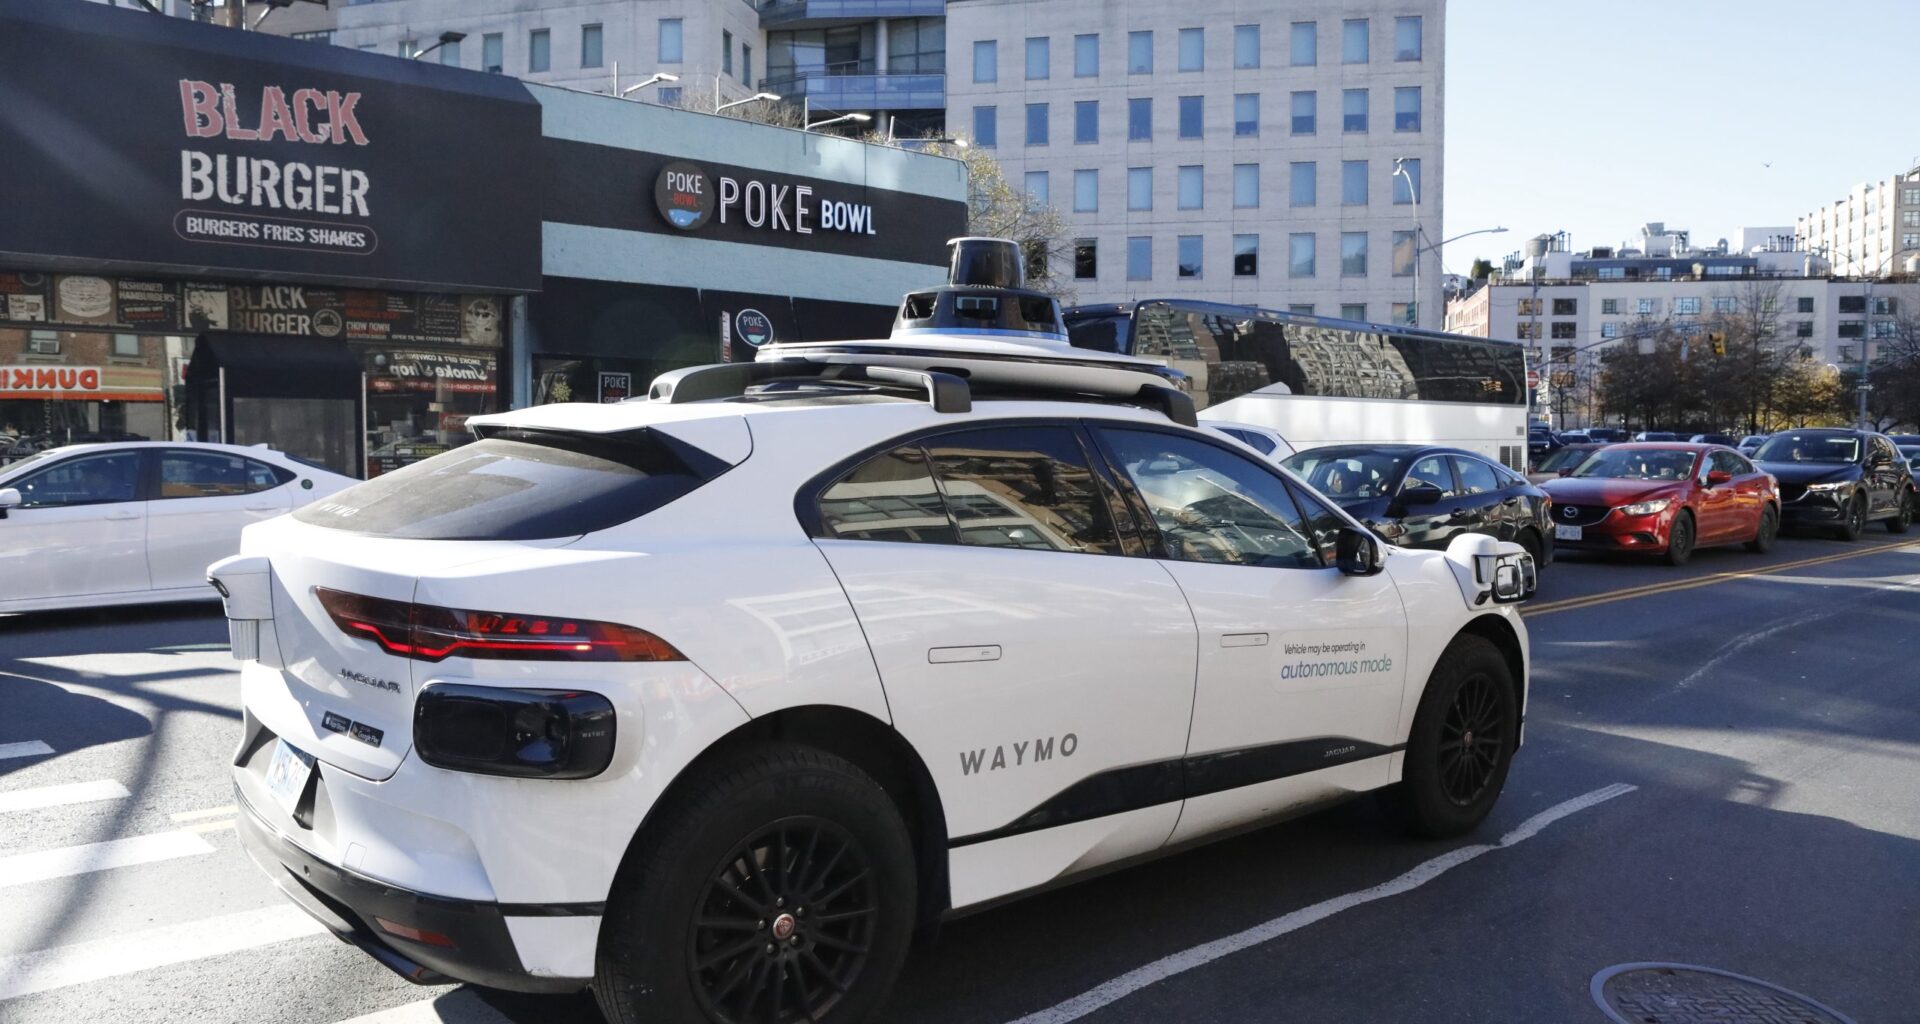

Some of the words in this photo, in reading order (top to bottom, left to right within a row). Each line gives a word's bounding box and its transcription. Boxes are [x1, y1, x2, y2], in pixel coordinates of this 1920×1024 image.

[179, 79, 370, 145] BLACK
[181, 150, 370, 216] BURGER
[667, 171, 703, 194] POKE
[672, 193, 699, 207] BOWL
[720, 177, 813, 234] POKE
[821, 199, 876, 235] BOWL
[186, 216, 260, 238] BURGERS
[263, 224, 305, 243] FRIES
[308, 228, 366, 247] SHAKES
[229, 285, 308, 309] BLACK
[230, 312, 311, 335] BURGER
[742, 315, 764, 328] POKE
[604, 376, 627, 389] POKE
[1284, 643, 1307, 655] Vehicle
[1307, 646, 1321, 656] may
[1322, 642, 1331, 653] be
[1331, 642, 1359, 654] operating
[1359, 641, 1366, 651] in
[1281, 661, 1358, 679] autonomous
[1360, 653, 1392, 673] mode
[338, 668, 401, 694] JAGUAR
[960, 733, 1078, 775] WAYMO
[1323, 745, 1356, 757] JAGUAR
